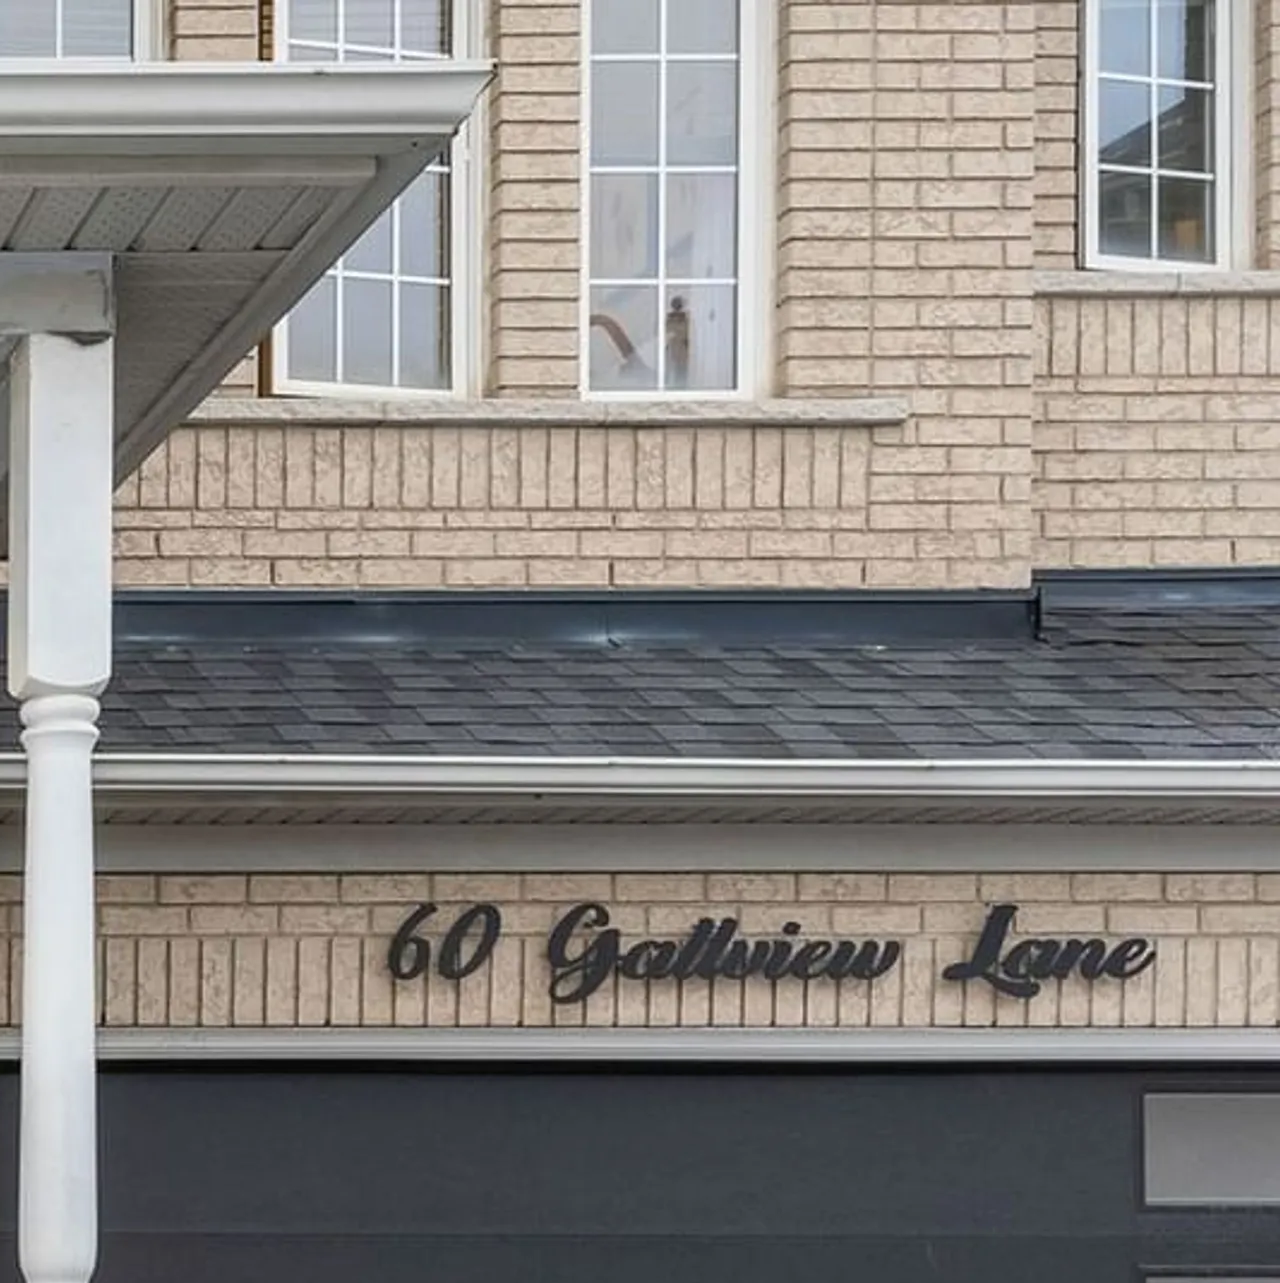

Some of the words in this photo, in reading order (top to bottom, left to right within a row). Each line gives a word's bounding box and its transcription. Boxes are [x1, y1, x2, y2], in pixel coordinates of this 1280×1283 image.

[388, 902, 501, 980] 60
[547, 902, 901, 1004] Gallview
[942, 903, 1157, 999] Lane
